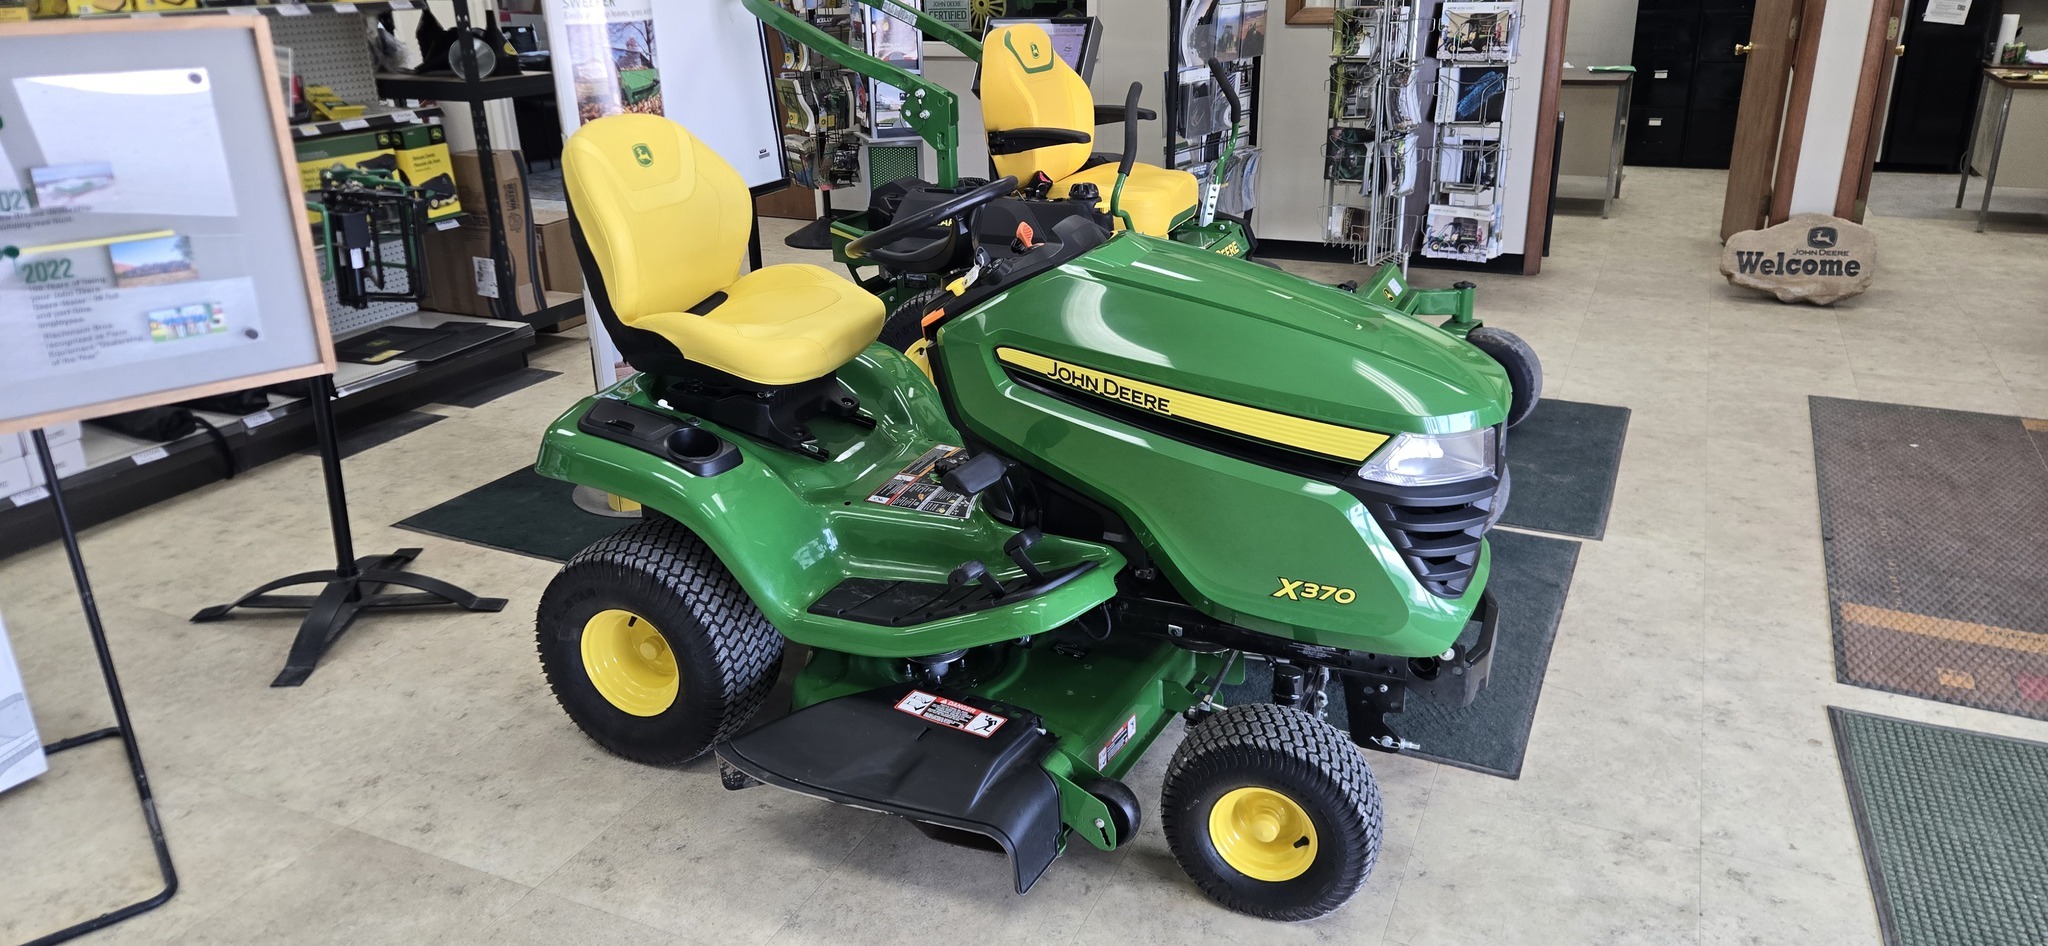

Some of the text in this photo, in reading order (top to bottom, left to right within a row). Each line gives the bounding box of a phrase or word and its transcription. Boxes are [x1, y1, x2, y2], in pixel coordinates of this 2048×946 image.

[929, 10, 967, 20] CERTIFIED
[0, 188, 34, 213] 021
[1736, 250, 1861, 277] Welcome
[1819, 249, 1849, 257] DEERE
[22, 259, 74, 283] 2022
[1047, 362, 1171, 413] JOHN DEERE
[1270, 576, 1357, 605] X370
[947, 701, 976, 713] DANGER
